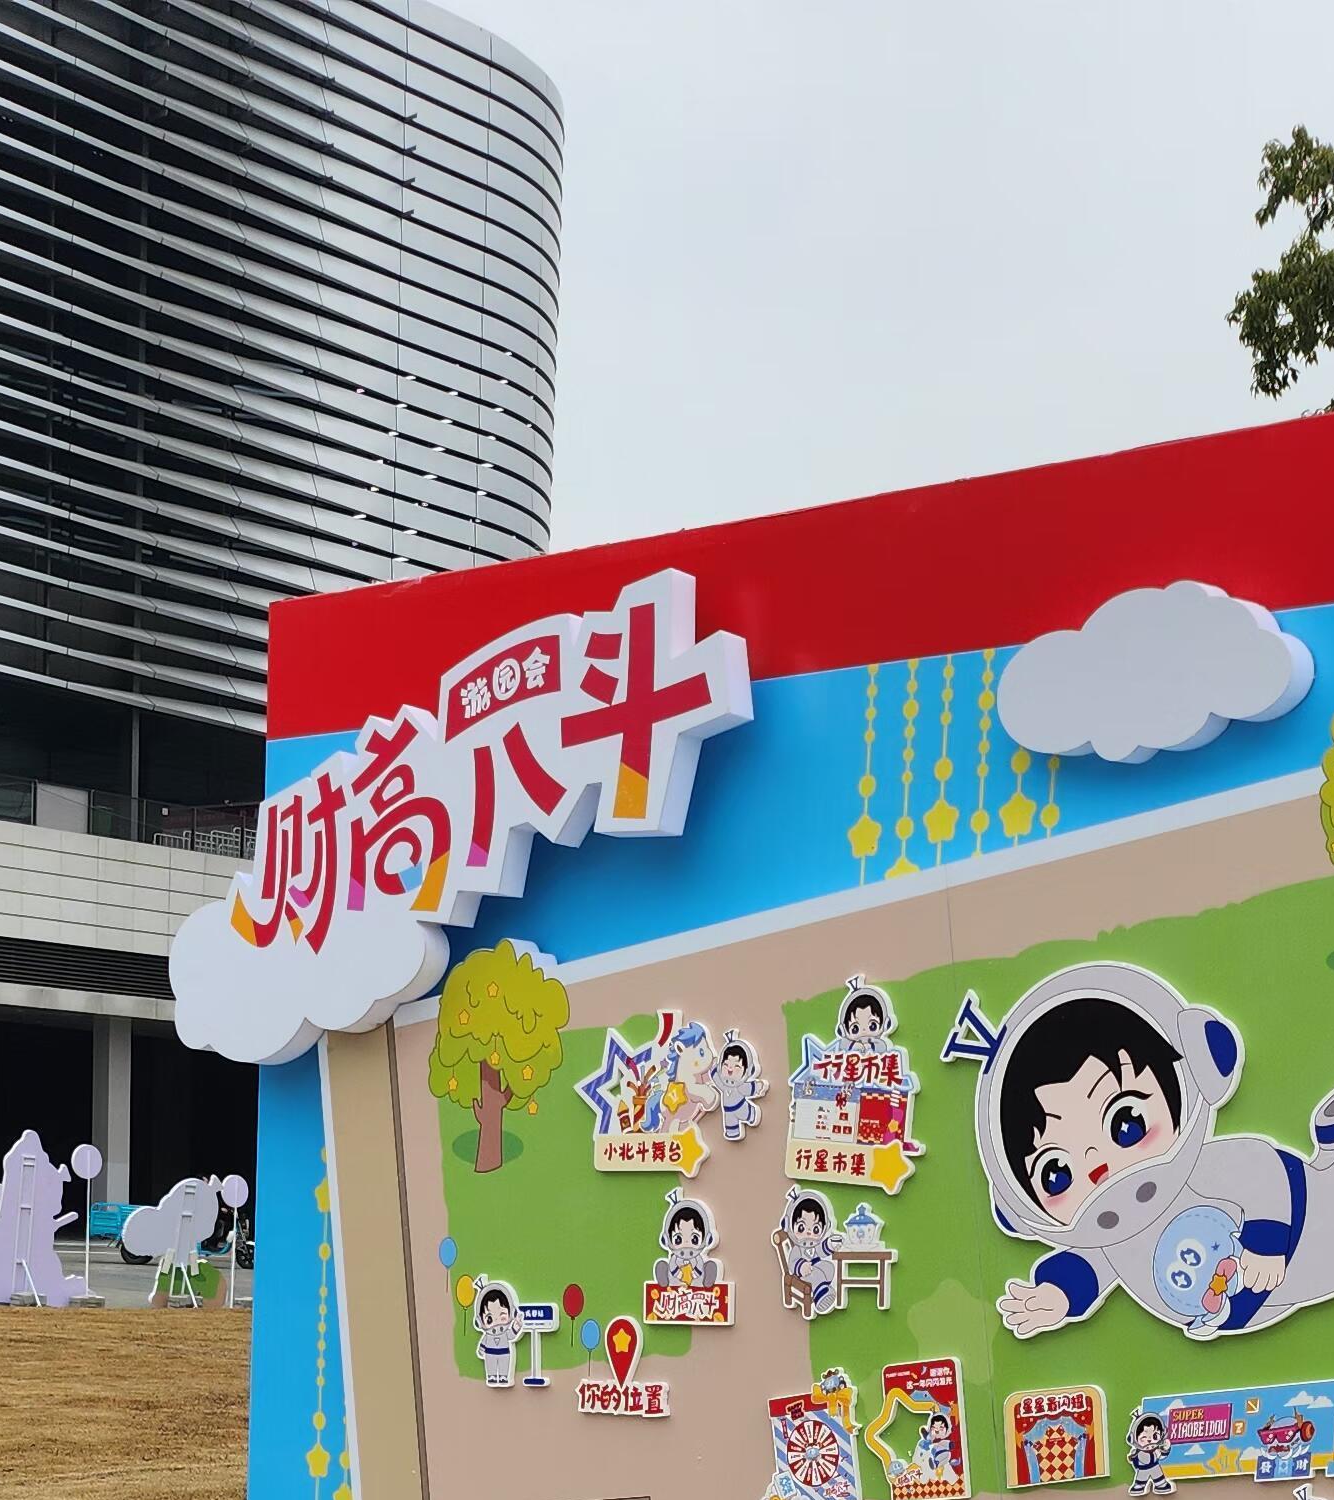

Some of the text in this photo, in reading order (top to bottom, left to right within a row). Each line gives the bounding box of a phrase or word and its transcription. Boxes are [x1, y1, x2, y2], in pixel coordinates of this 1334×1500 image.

[460, 645, 552, 721] 游园会
[230, 602, 713, 955] 财高八斗
[812, 1052, 904, 1087] 行星市集
[603, 1140, 682, 1163] 小北斗舞台
[795, 1148, 866, 1177] 行星市集
[578, 1382, 665, 1415] 你的位置
[1170, 1418, 1228, 1440] XIAOBEIDOU
[1172, 1408, 1204, 1421] SUPER
